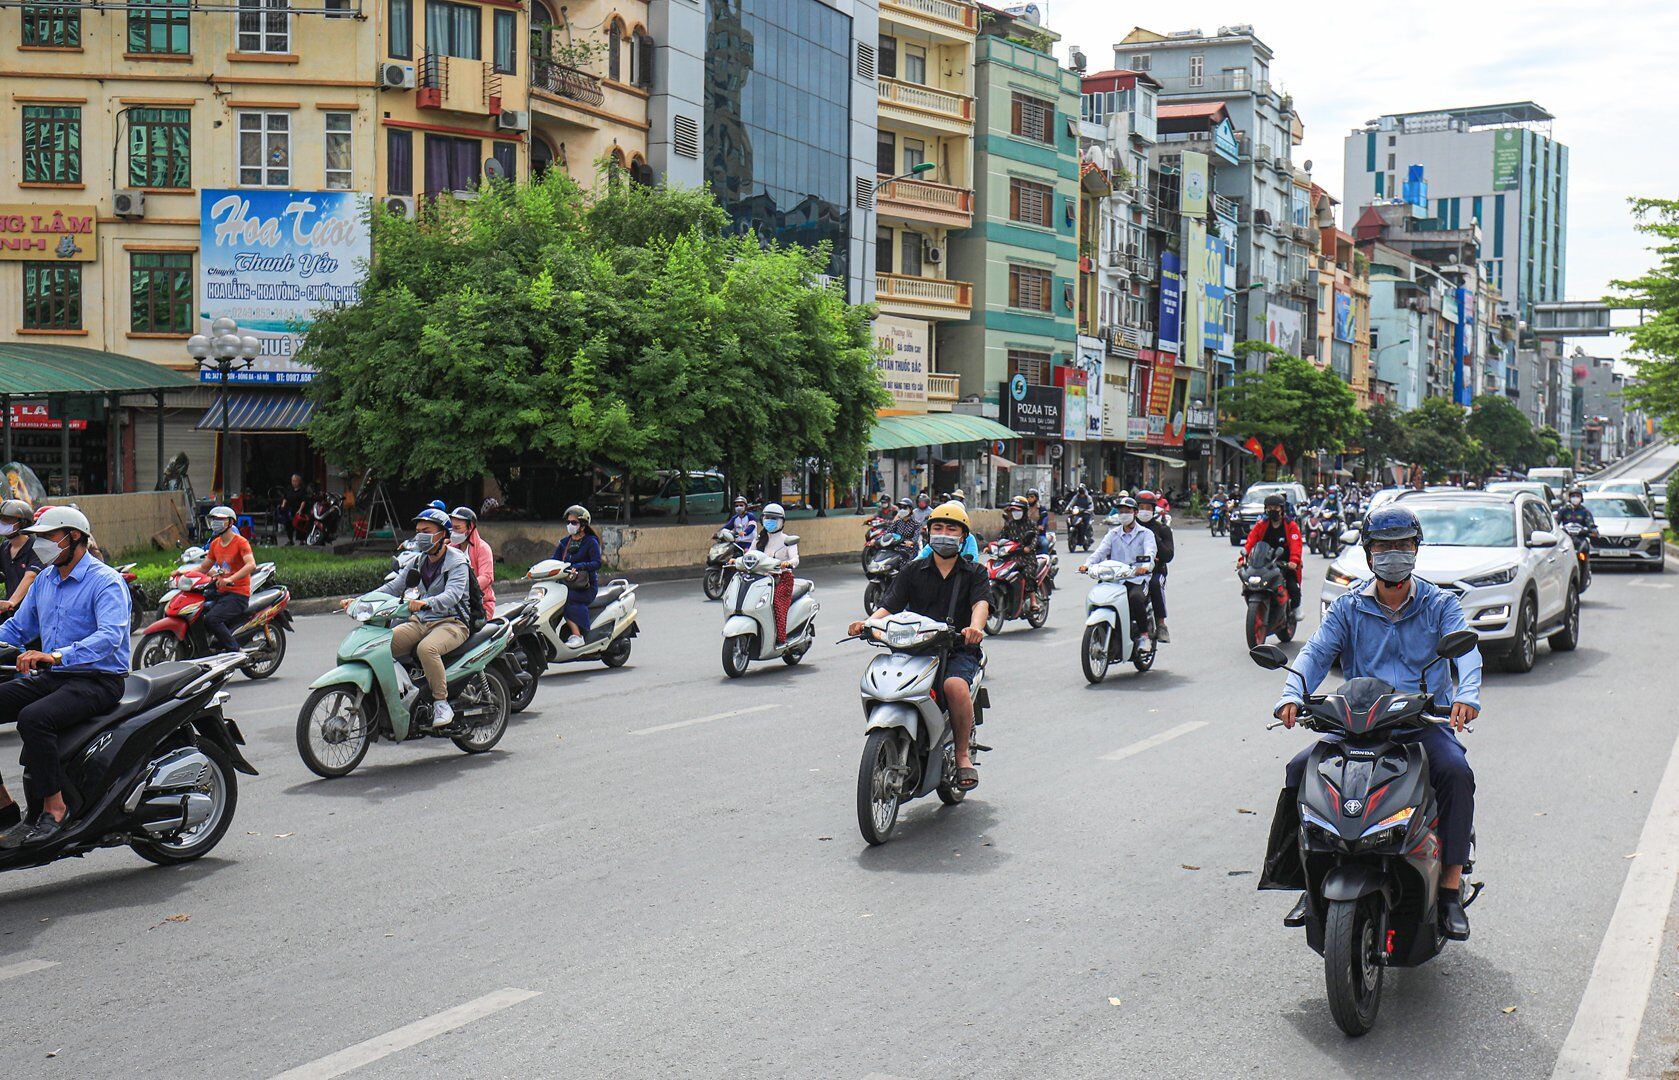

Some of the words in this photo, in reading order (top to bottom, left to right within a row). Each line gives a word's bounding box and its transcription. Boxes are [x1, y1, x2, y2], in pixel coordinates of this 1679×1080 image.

[31, 209, 92, 233] LÂM
[211, 195, 282, 247] Hoa
[235, 252, 295, 272] Thanh
[299, 251, 339, 278] Yến
[207, 282, 226, 299] HOA
[256, 283, 275, 300] HOA
[258, 335, 291, 357] HUÊ
[1017, 403, 1042, 415] POZAA
[1044, 405, 1058, 416] TEA
